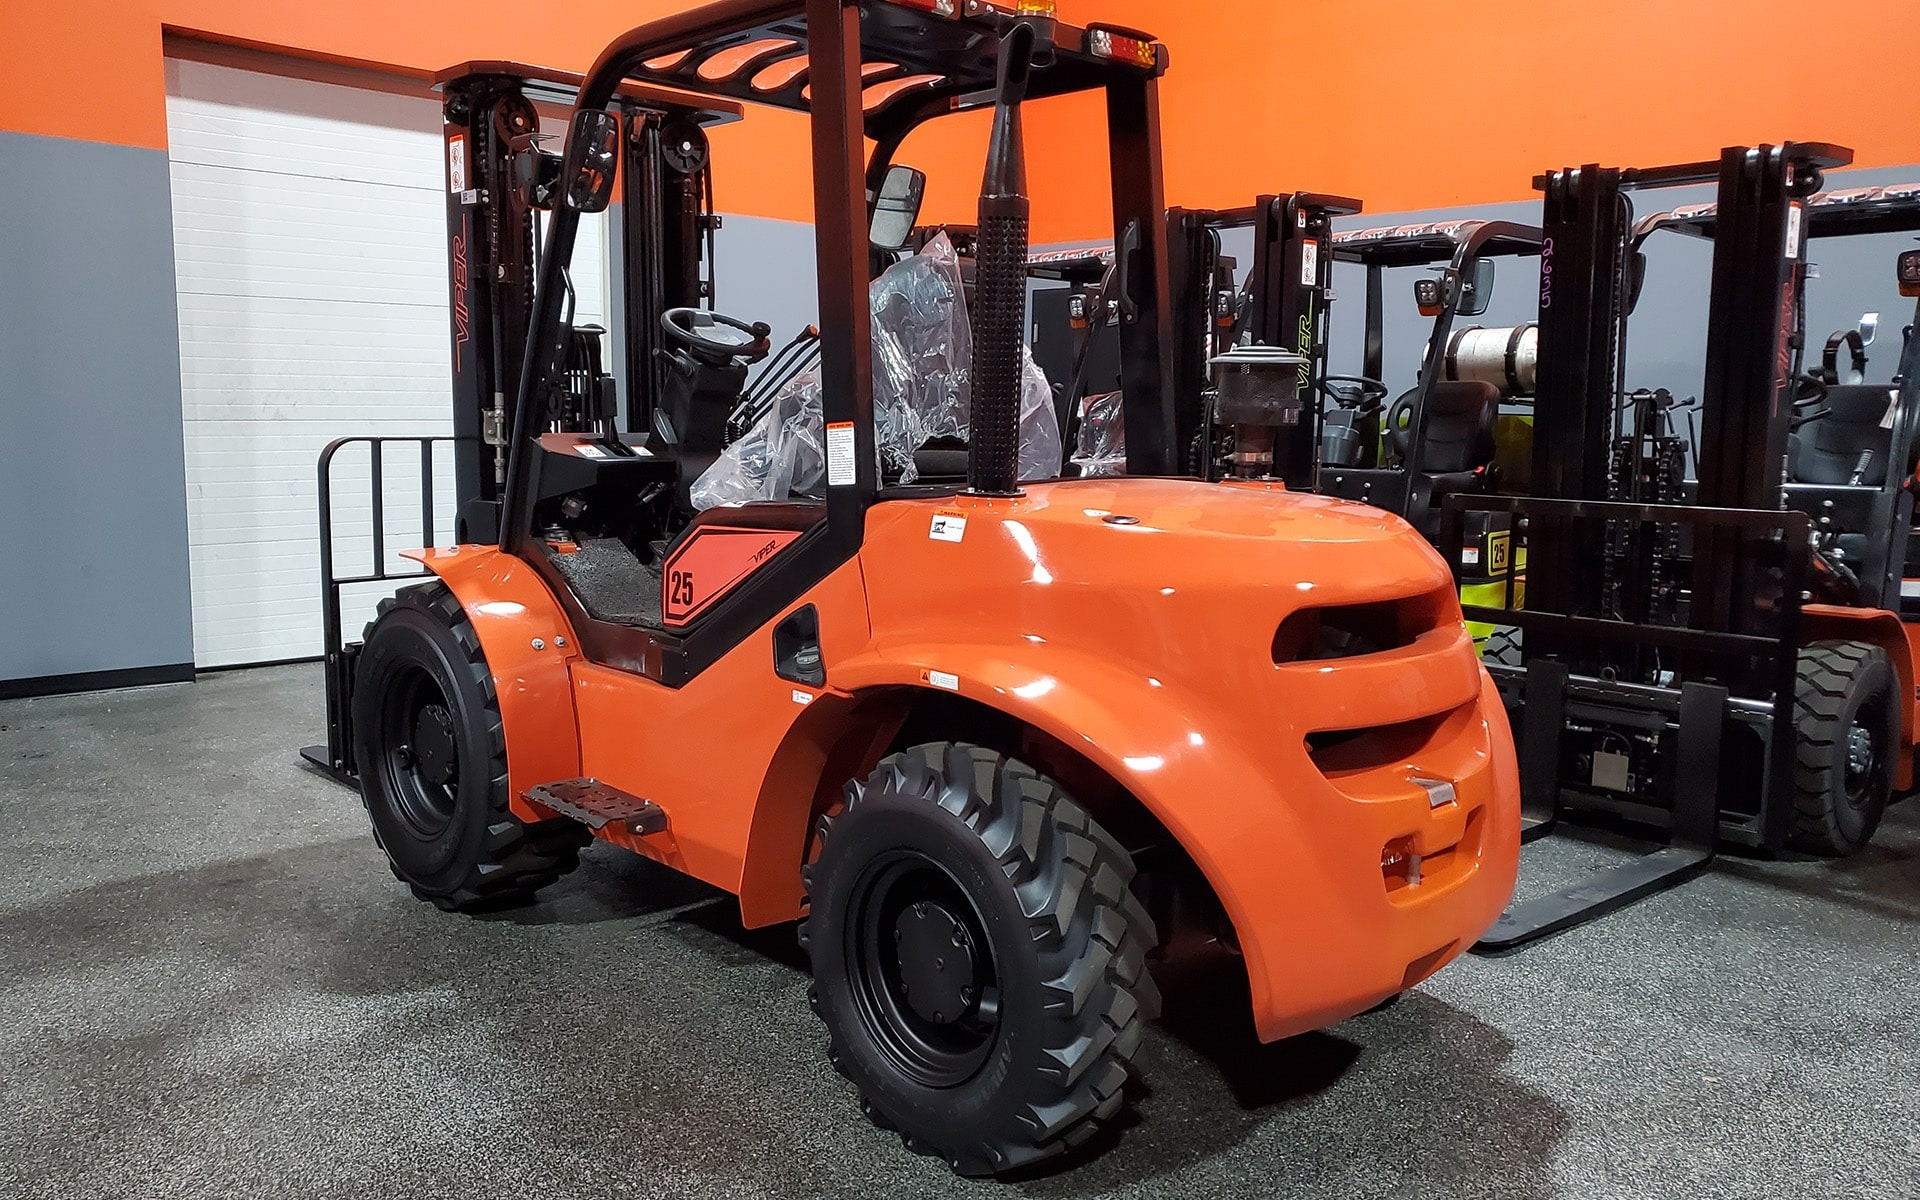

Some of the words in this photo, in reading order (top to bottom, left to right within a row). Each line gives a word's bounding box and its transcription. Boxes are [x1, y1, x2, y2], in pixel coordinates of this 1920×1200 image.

[1541, 237, 1554, 309] 2635
[452, 213, 470, 373] VIPER
[747, 540, 781, 563] VIPER
[1494, 543, 1505, 564] 25
[671, 570, 694, 606] 25
